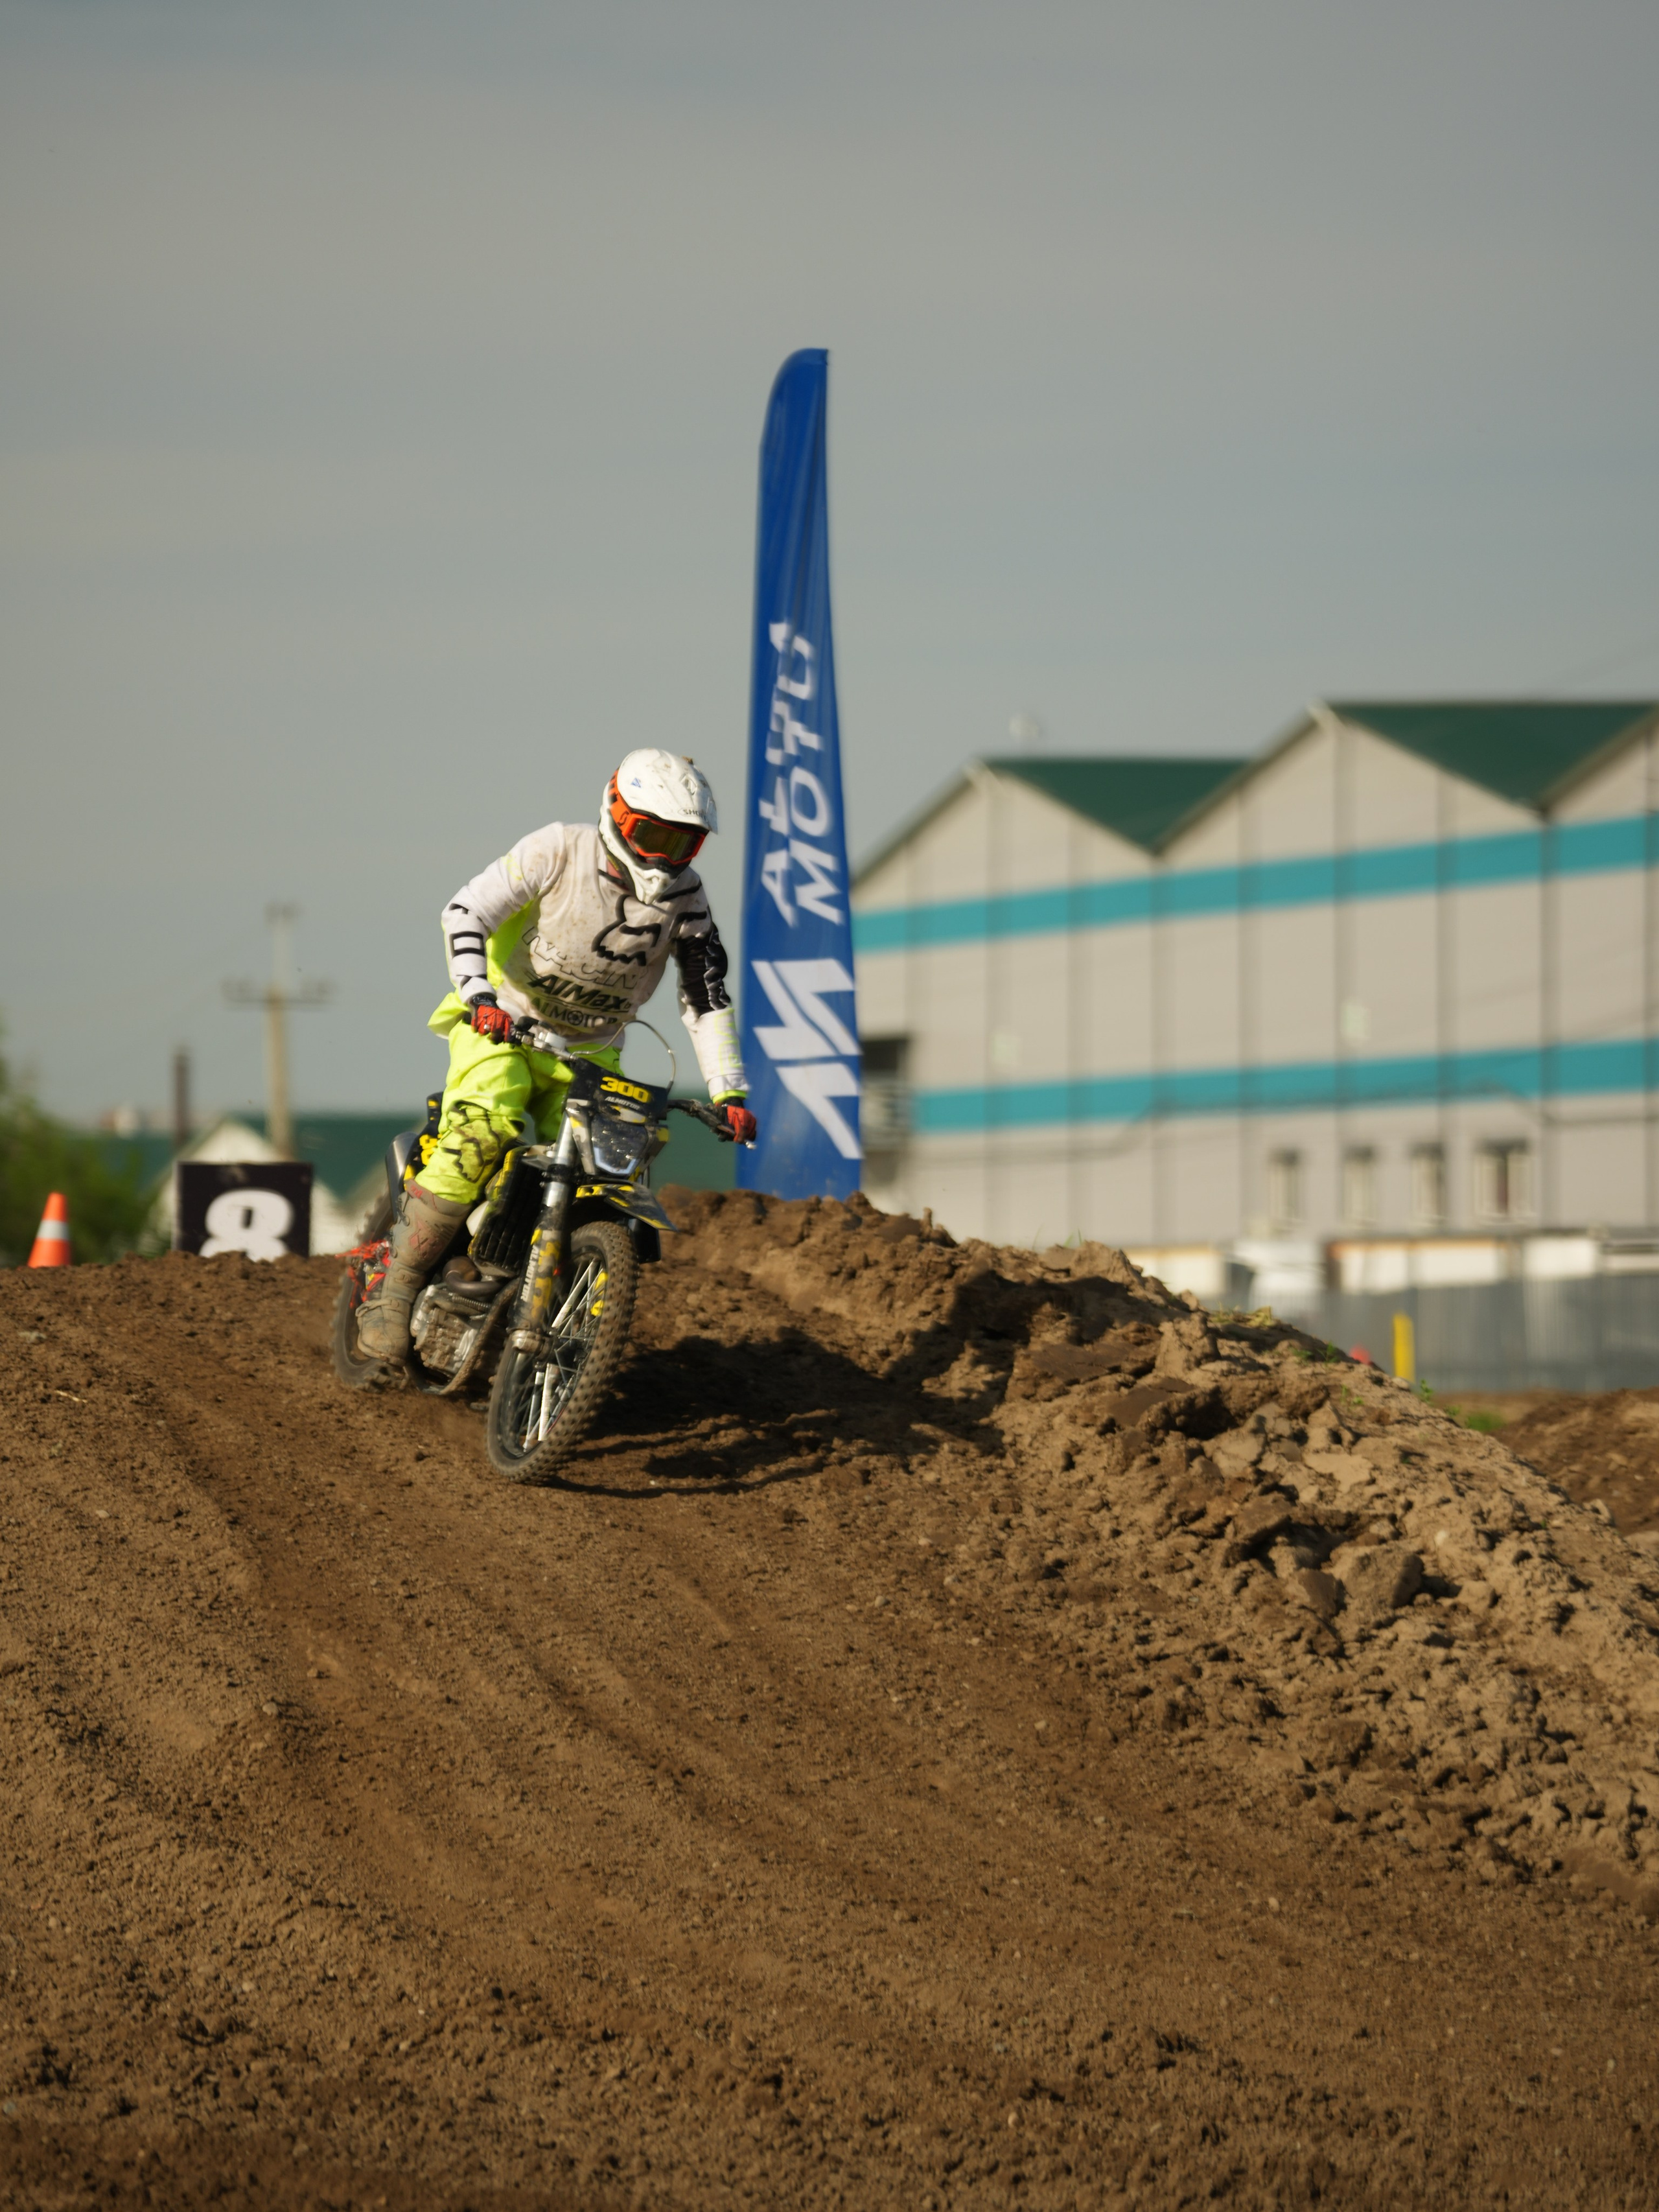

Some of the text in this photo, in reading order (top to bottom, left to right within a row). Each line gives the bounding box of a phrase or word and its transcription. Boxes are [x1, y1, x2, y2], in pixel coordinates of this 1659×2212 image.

[600, 1077, 651, 1103] 300
[200, 1188, 294, 1263] 8
[520, 1244, 539, 1302] ALMOTOR
